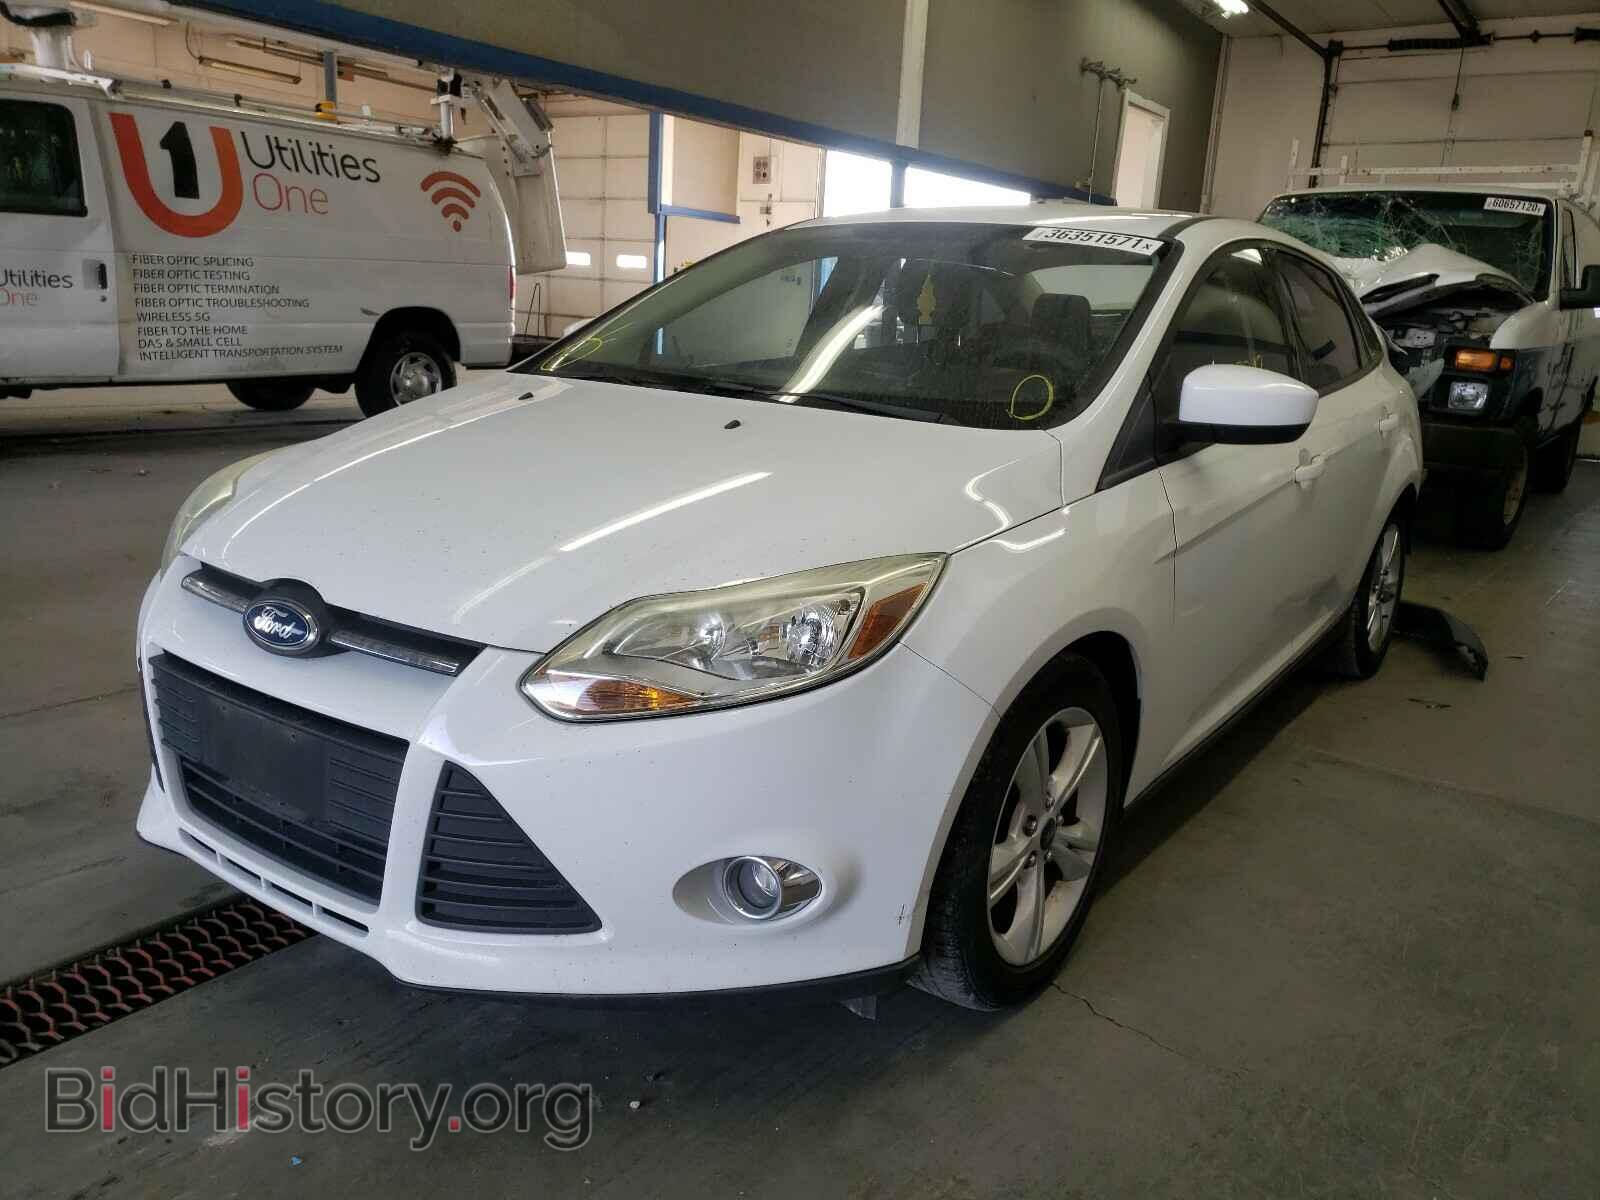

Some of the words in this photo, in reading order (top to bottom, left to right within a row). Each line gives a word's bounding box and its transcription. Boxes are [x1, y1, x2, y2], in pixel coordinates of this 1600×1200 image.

[240, 131, 381, 184] Utilities
[252, 172, 329, 216] One
[132, 254, 164, 265] FIBER
[166, 255, 201, 266] OPTIC
[202, 256, 255, 268] SPLICING
[132, 268, 165, 280] FIBER
[167, 269, 202, 280] OPTIC
[202, 270, 251, 281] TESTING
[134, 283, 165, 294] FIBER
[167, 283, 202, 294] OPTIC
[204, 284, 281, 295] TERMINATION
[135, 297, 166, 308] FIBER
[168, 297, 205, 308] OPTIC
[206, 298, 310, 309] TROUBLESHOOTING
[136, 311, 193, 322] WIRELESS
[195, 311, 211, 322] 5G
[137, 326, 169, 337] FIBER
[170, 326, 188, 336] TO
[190, 325, 211, 336] THE
[213, 325, 249, 335] HOME
[138, 339, 163, 349] DAS
[165, 338, 174, 348] &
[175, 337, 213, 348] SMALL
[215, 337, 242, 347] CELL
[139, 349, 209, 360] INTELLIGENT
[213, 346, 305, 359] TRANSPORTATION
[305, 344, 343, 354] SYSTEM
[253, 606, 305, 640] Ford
